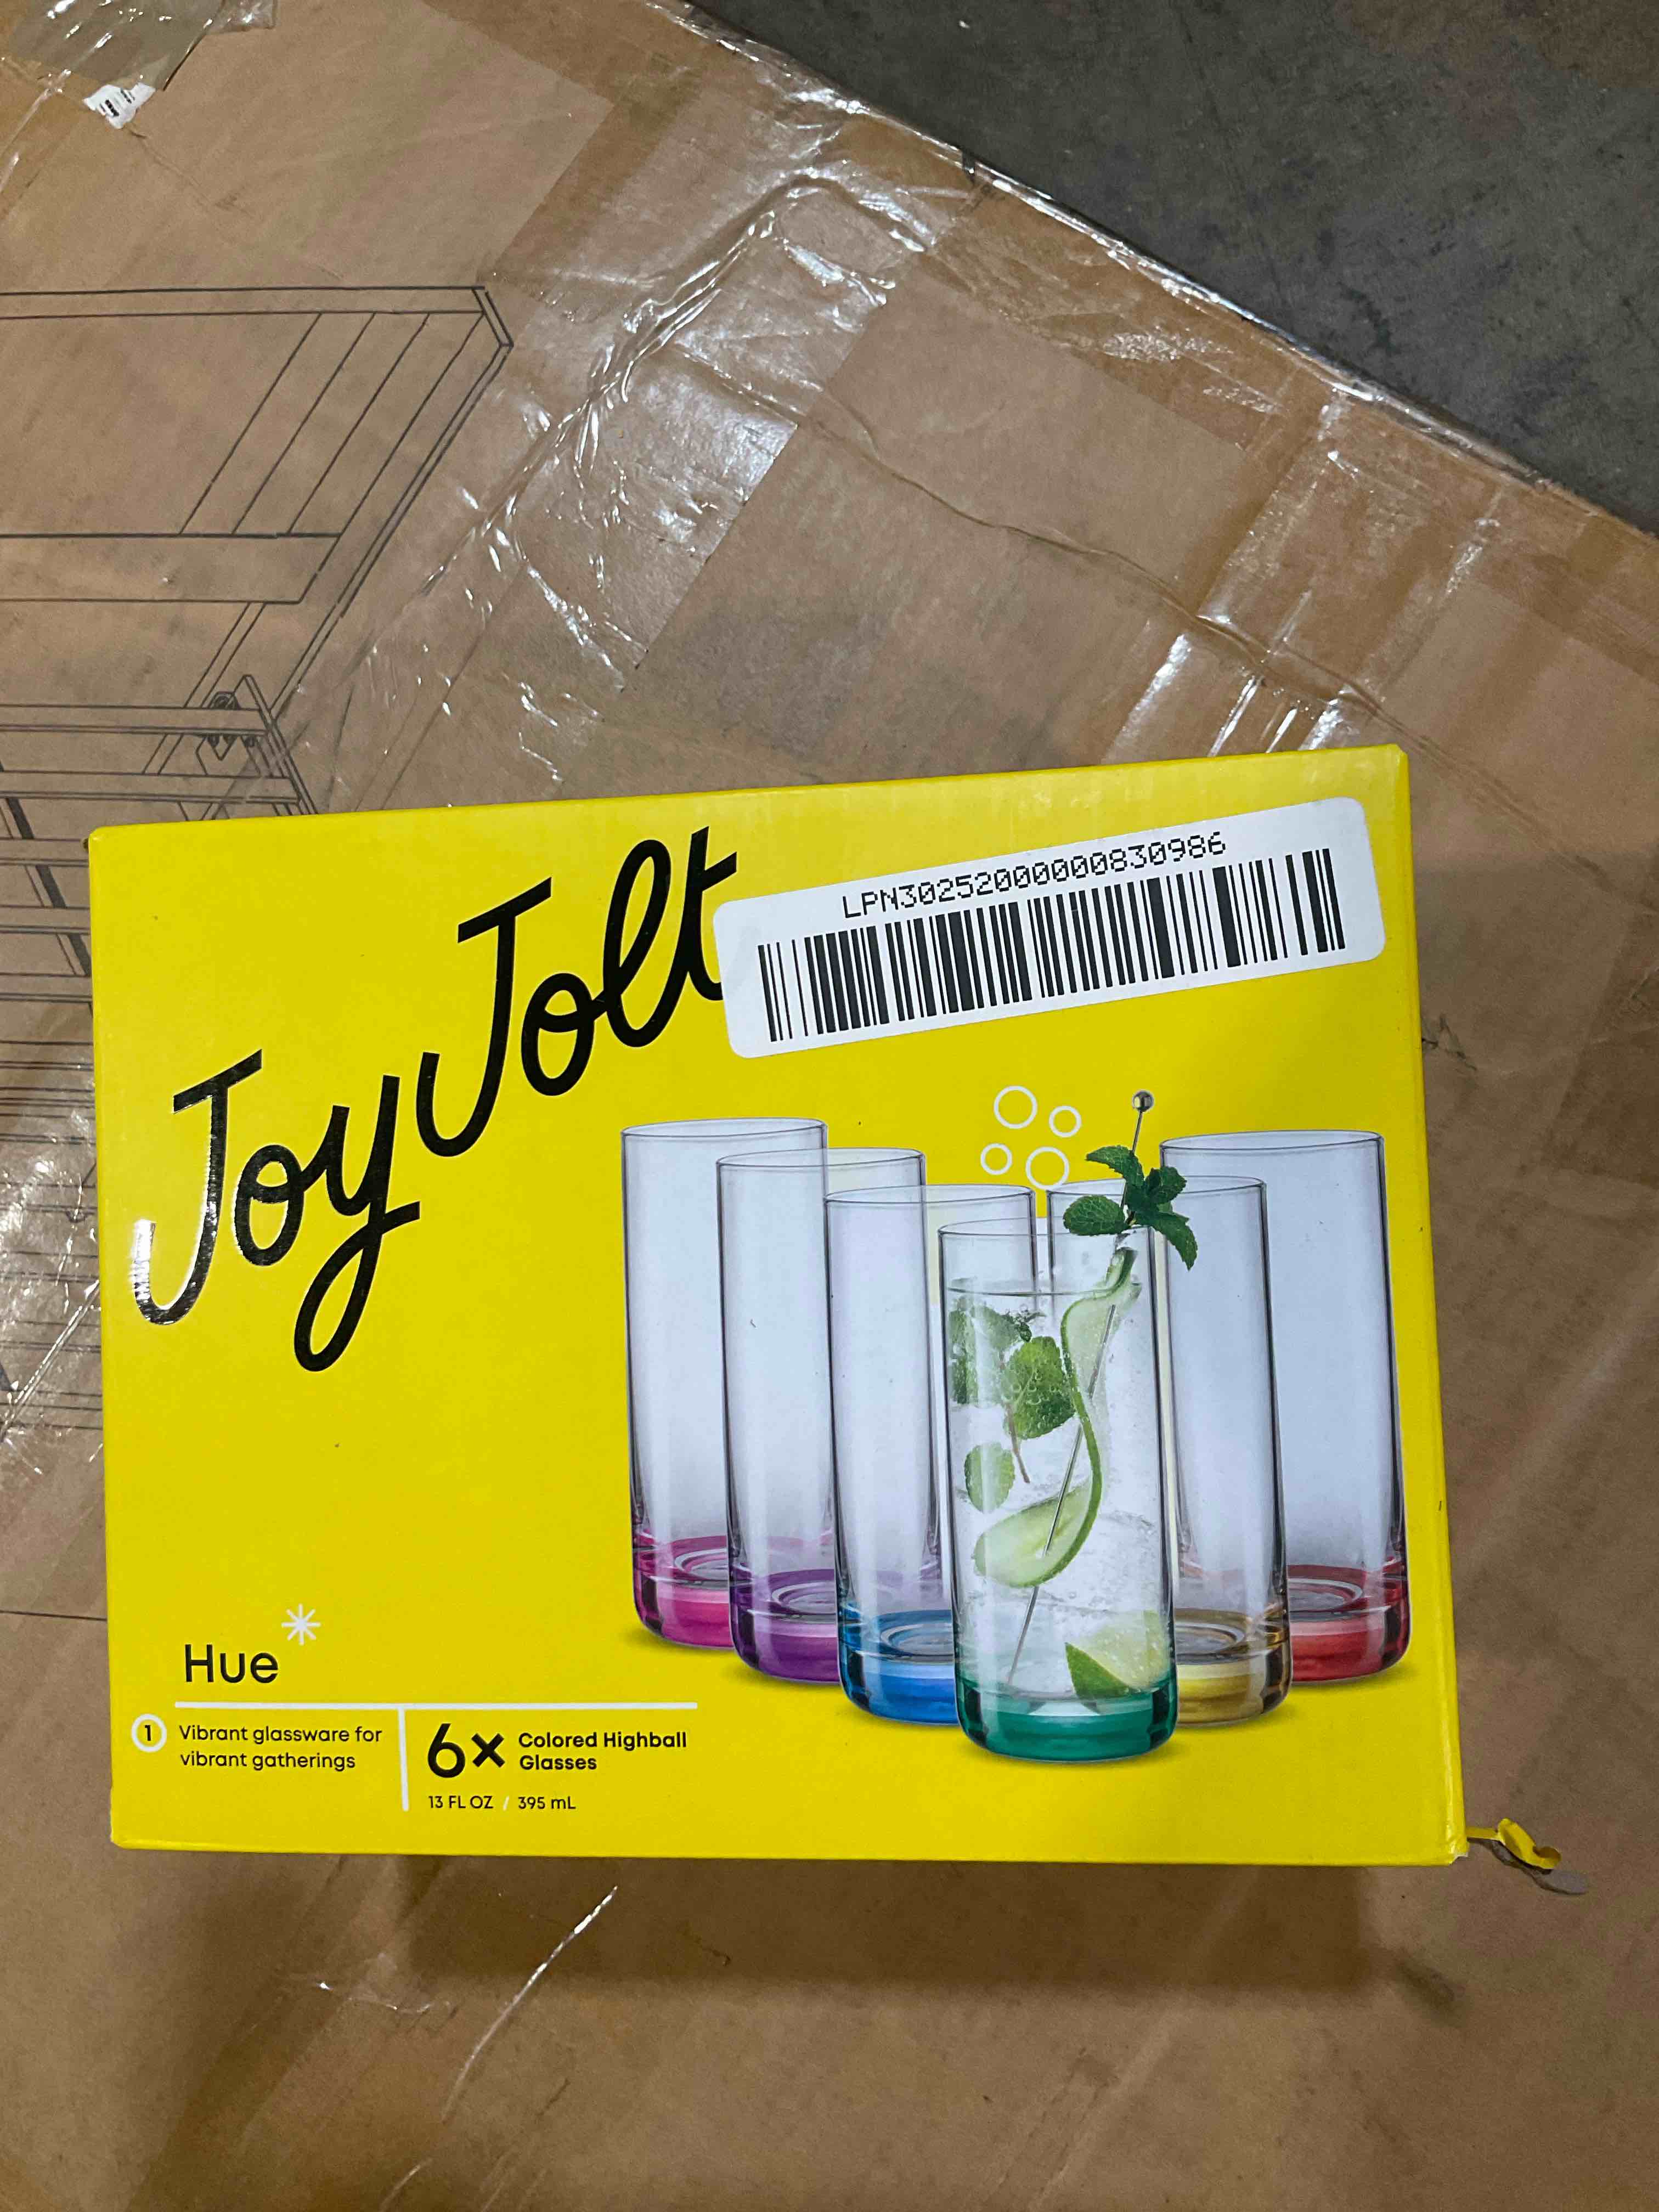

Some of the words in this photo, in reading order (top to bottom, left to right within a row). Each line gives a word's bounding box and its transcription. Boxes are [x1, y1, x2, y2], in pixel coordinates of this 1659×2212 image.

[842, 831, 1226, 918] LPN30252000000830986
[184, 1644, 279, 1684] Hue
[144, 1724, 152, 1742] 1
[178, 1724, 249, 1741] Vibrant
[252, 1725, 350, 1745] glassware
[354, 1726, 383, 1742] for
[518, 1731, 598, 1748] Colored
[603, 1731, 687, 1752] Highball
[179, 1751, 248, 1767] vibrant
[252, 1752, 356, 1772] gatherings
[519, 1754, 597, 1771] Glasses
[428, 1795, 444, 1809] 13
[448, 1795, 466, 1809] FL
[469, 1795, 494, 1809] OZ
[517, 1796, 546, 1810] 395
[550, 1796, 577, 1810] mL
